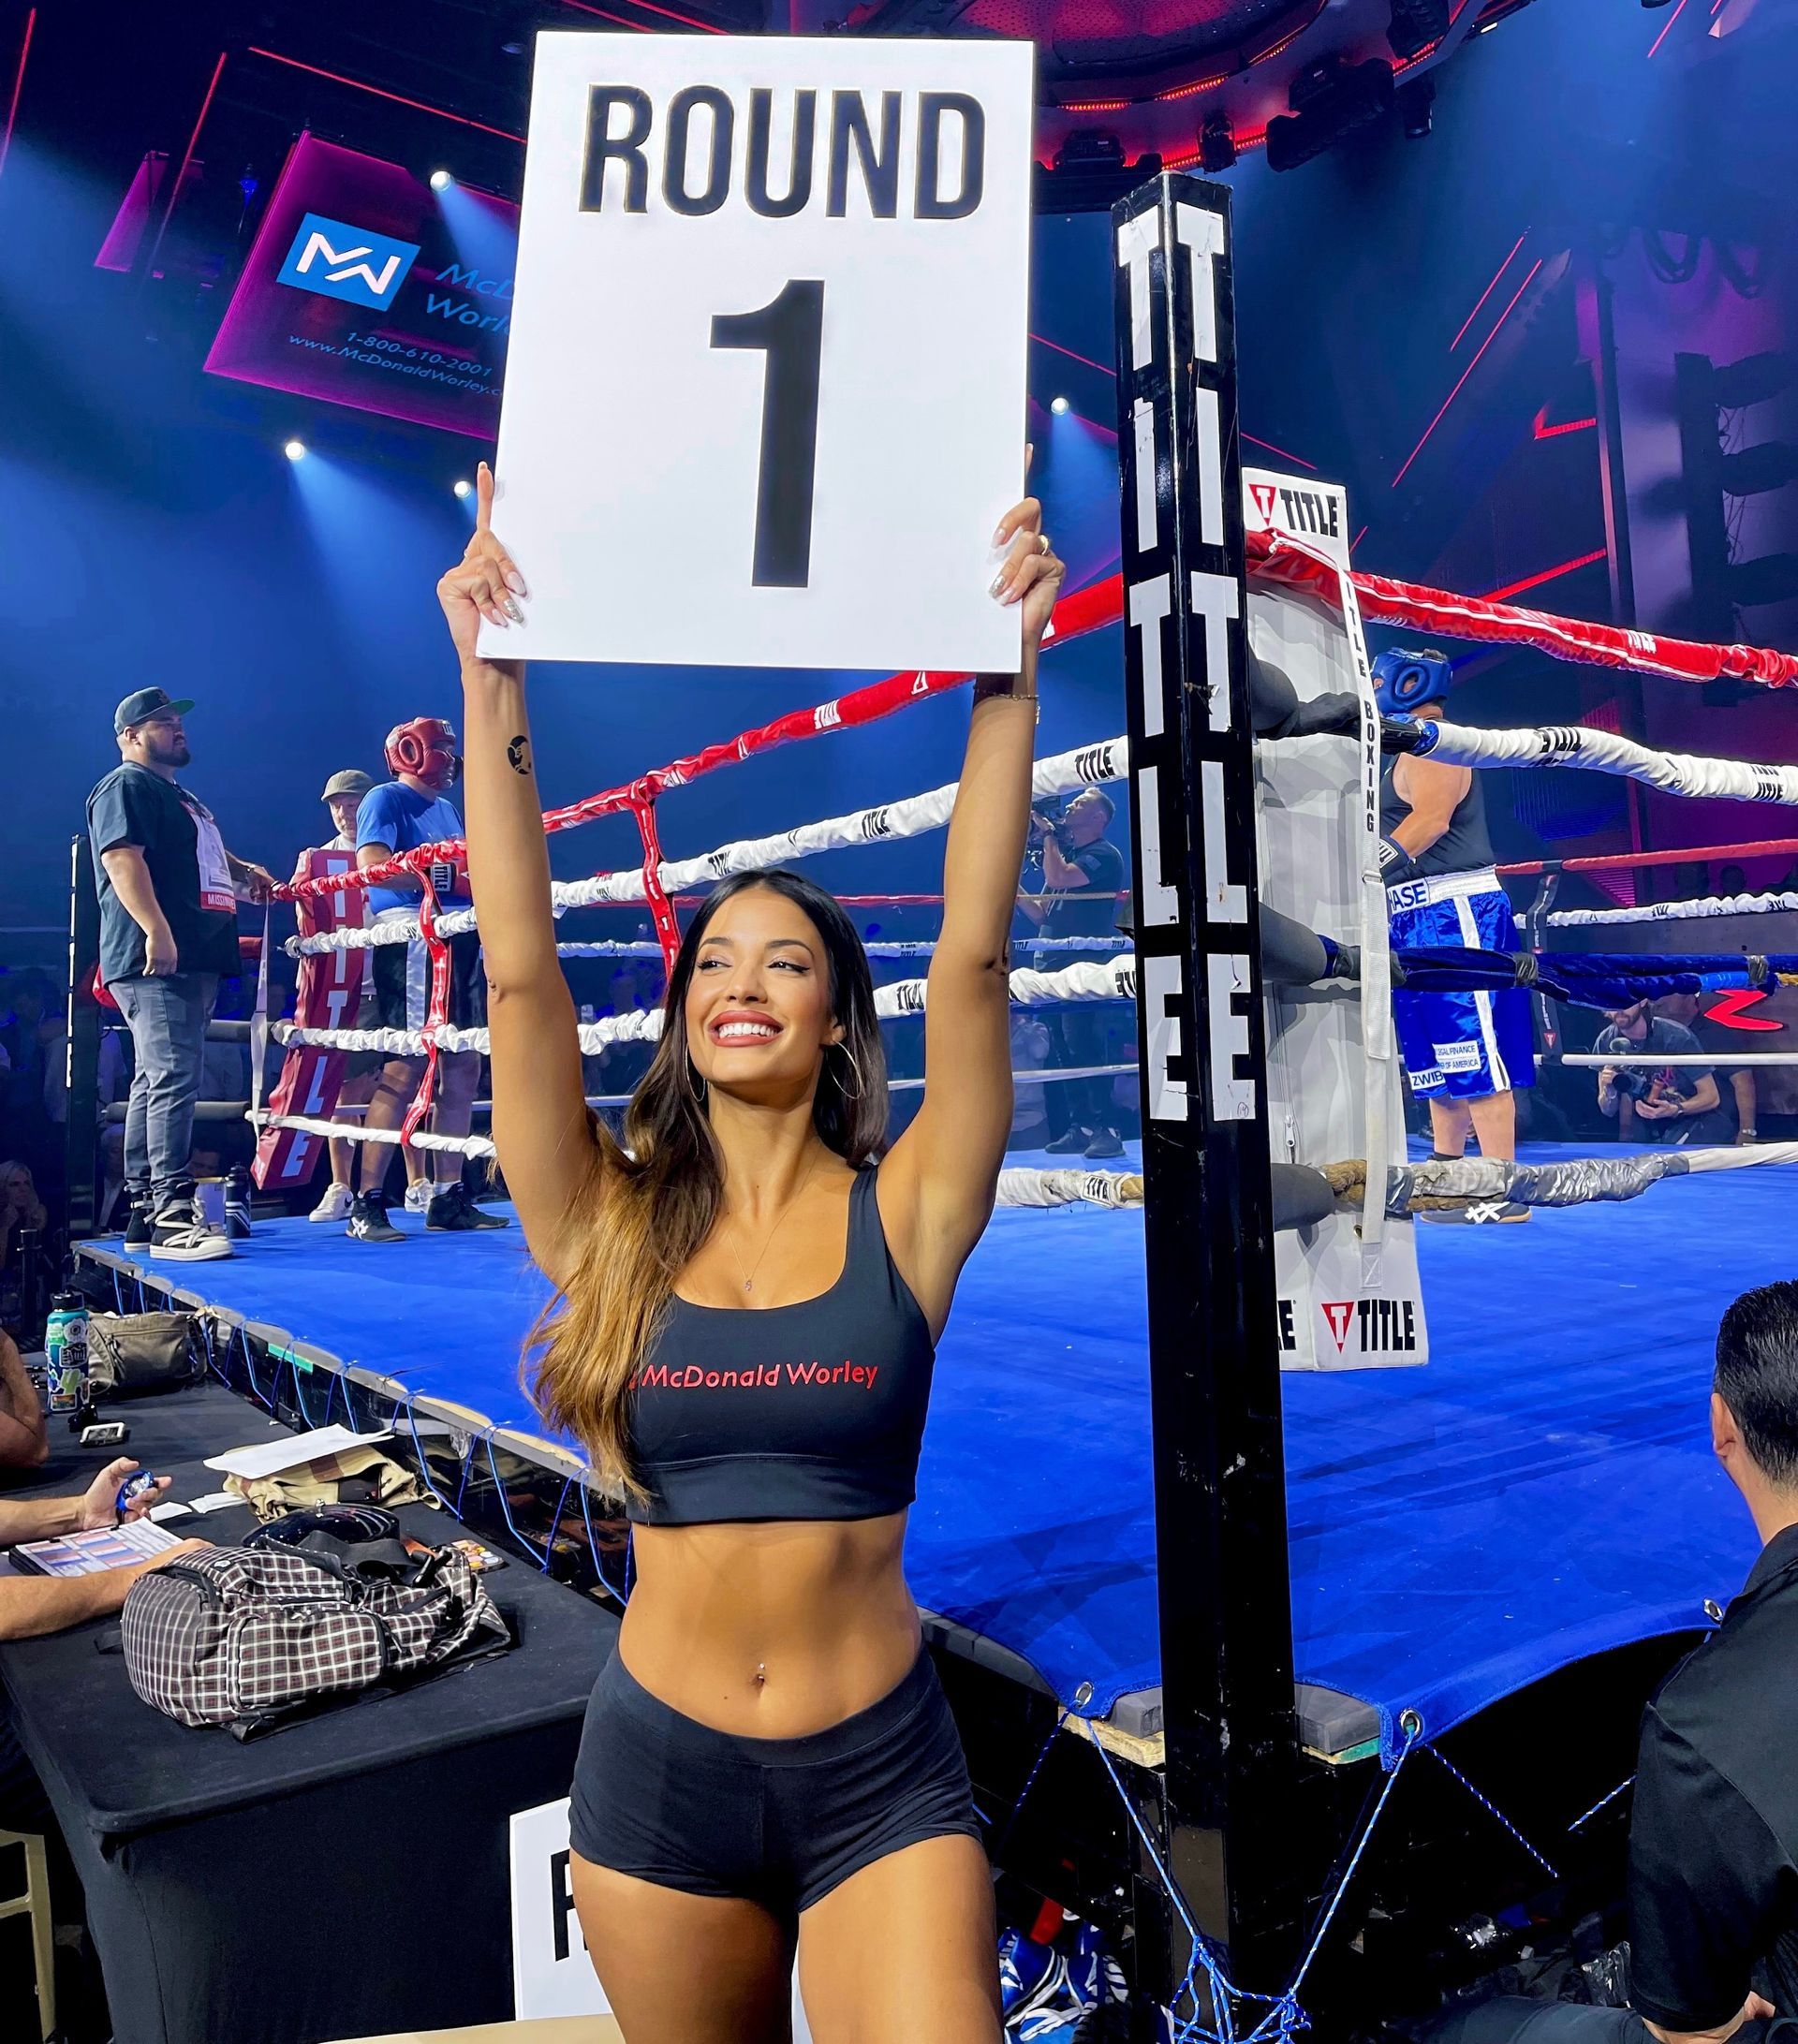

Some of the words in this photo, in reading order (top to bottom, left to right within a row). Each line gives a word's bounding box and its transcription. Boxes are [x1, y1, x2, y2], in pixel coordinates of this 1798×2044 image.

[579, 84, 985, 219] ROUND
[427, 293, 510, 333] Worl
[288, 334, 503, 396] www.McDonaldWorley.c
[346, 331, 493, 376] 1-800-610-2001
[710, 279, 825, 587] 1
[1279, 488, 1339, 537] TITLE
[1176, 201, 1256, 1121] TITLE
[1075, 745, 1116, 784] TITLE
[1363, 700, 1375, 832] BOXING
[434, 865, 449, 890] TITLE
[1389, 882, 1428, 912] ASE
[1358, 1299, 1415, 1352] TITLE
[641, 1363, 781, 1389] McDonald
[786, 1360, 878, 1390] Worley
